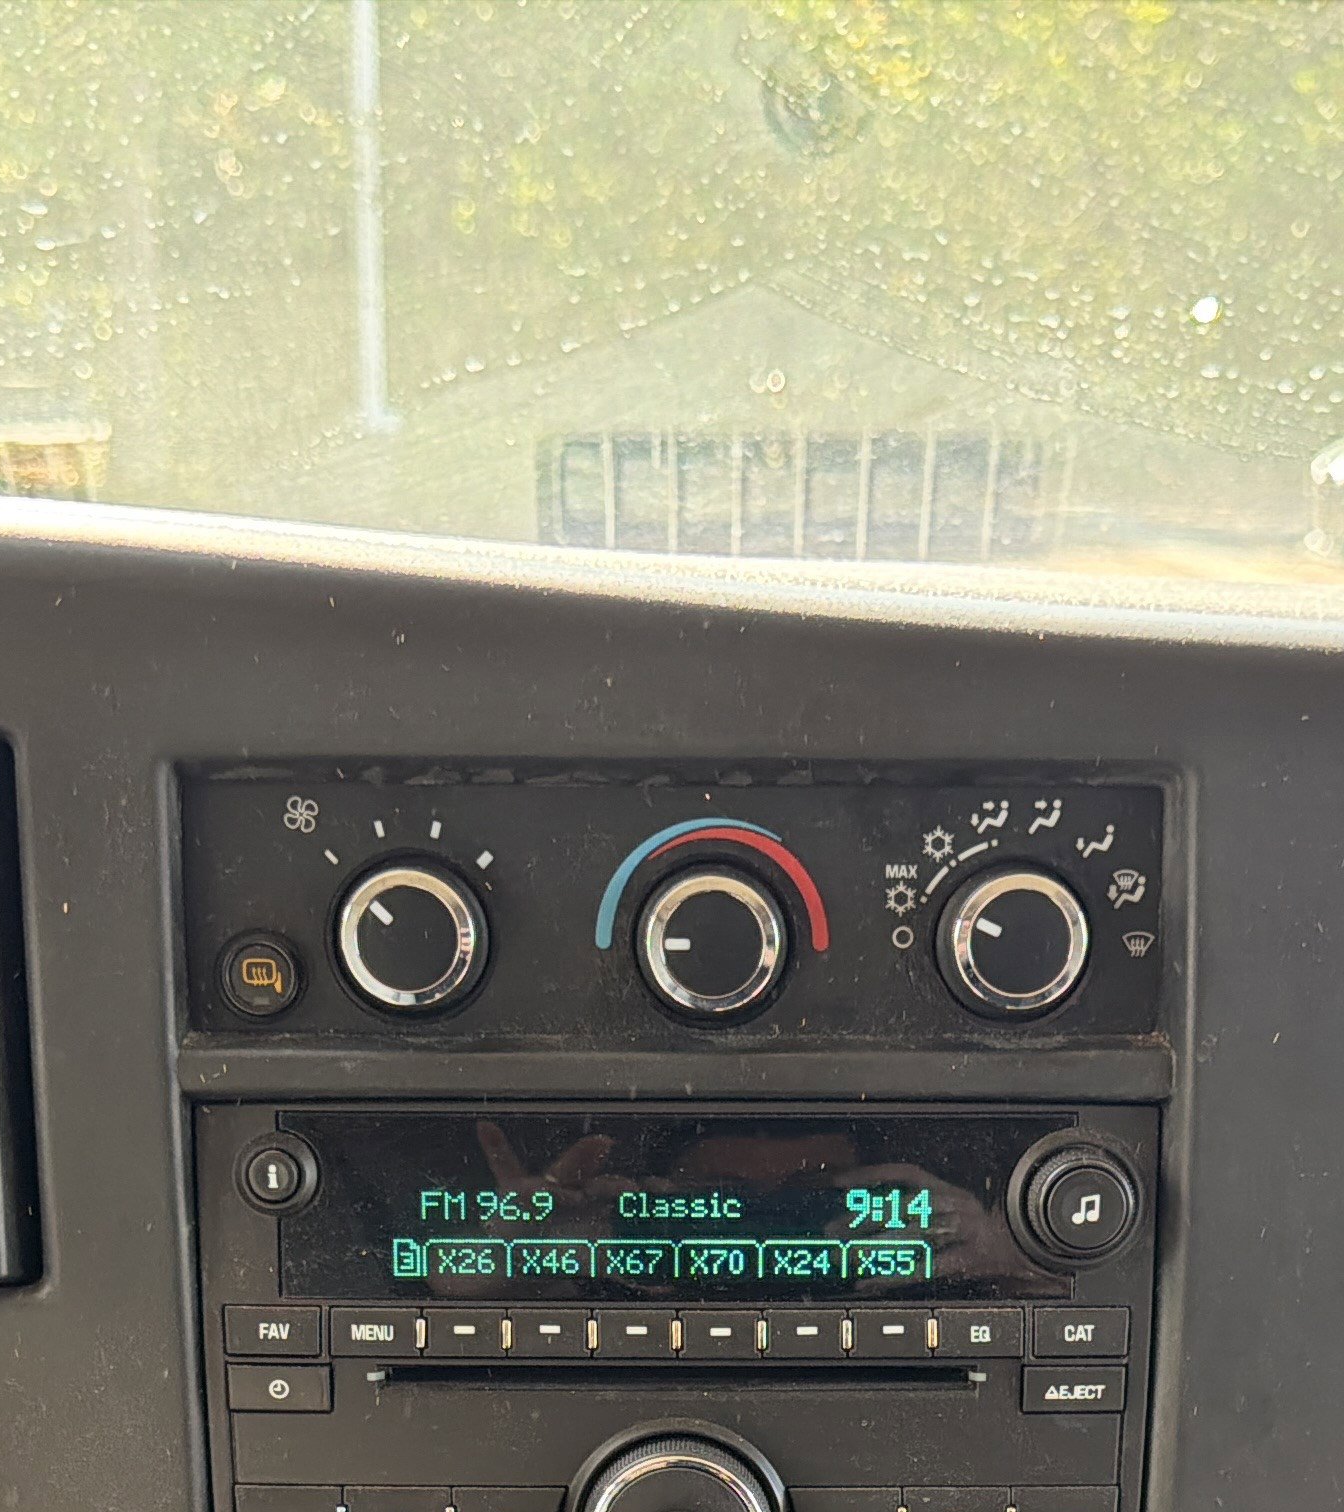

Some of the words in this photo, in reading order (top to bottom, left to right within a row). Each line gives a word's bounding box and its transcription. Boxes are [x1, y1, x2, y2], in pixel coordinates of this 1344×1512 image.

[885, 864, 918, 880] MAX
[420, 1191, 466, 1220] FM
[476, 1191, 554, 1221] 96.9
[618, 1191, 742, 1218] Classic
[846, 1188, 933, 1229] 9:14
[437, 1249, 496, 1274] X26
[522, 1249, 579, 1274] X46
[606, 1249, 663, 1274] X67
[690, 1249, 745, 1275] X70
[774, 1249, 831, 1275] X24
[857, 1249, 915, 1275] X55
[258, 1322, 290, 1340] FAV
[351, 1323, 394, 1341] MENU
[970, 1325, 991, 1343] EQ
[1064, 1324, 1095, 1342] CAT
[1059, 1384, 1106, 1400] EJECT
